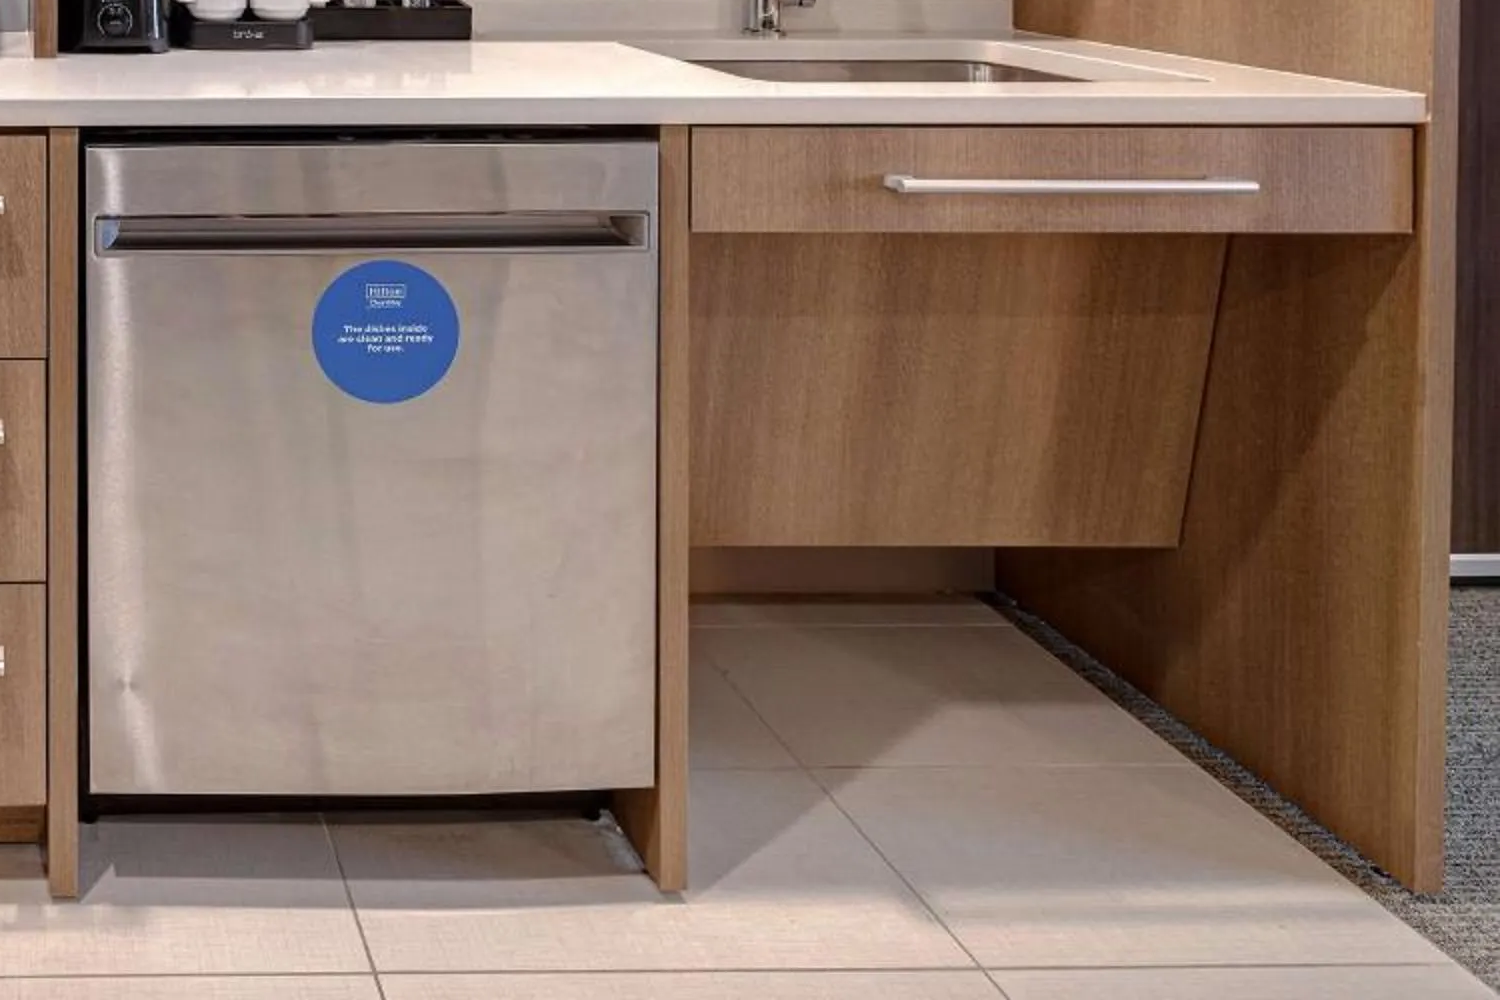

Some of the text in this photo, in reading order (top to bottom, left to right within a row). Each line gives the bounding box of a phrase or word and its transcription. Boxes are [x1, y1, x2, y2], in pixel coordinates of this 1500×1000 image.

[343, 325, 363, 333] The
[364, 324, 396, 333] dishes
[356, 334, 383, 343] clean
[384, 334, 403, 343] and
[405, 334, 435, 345] ready
[367, 344, 382, 353] for
